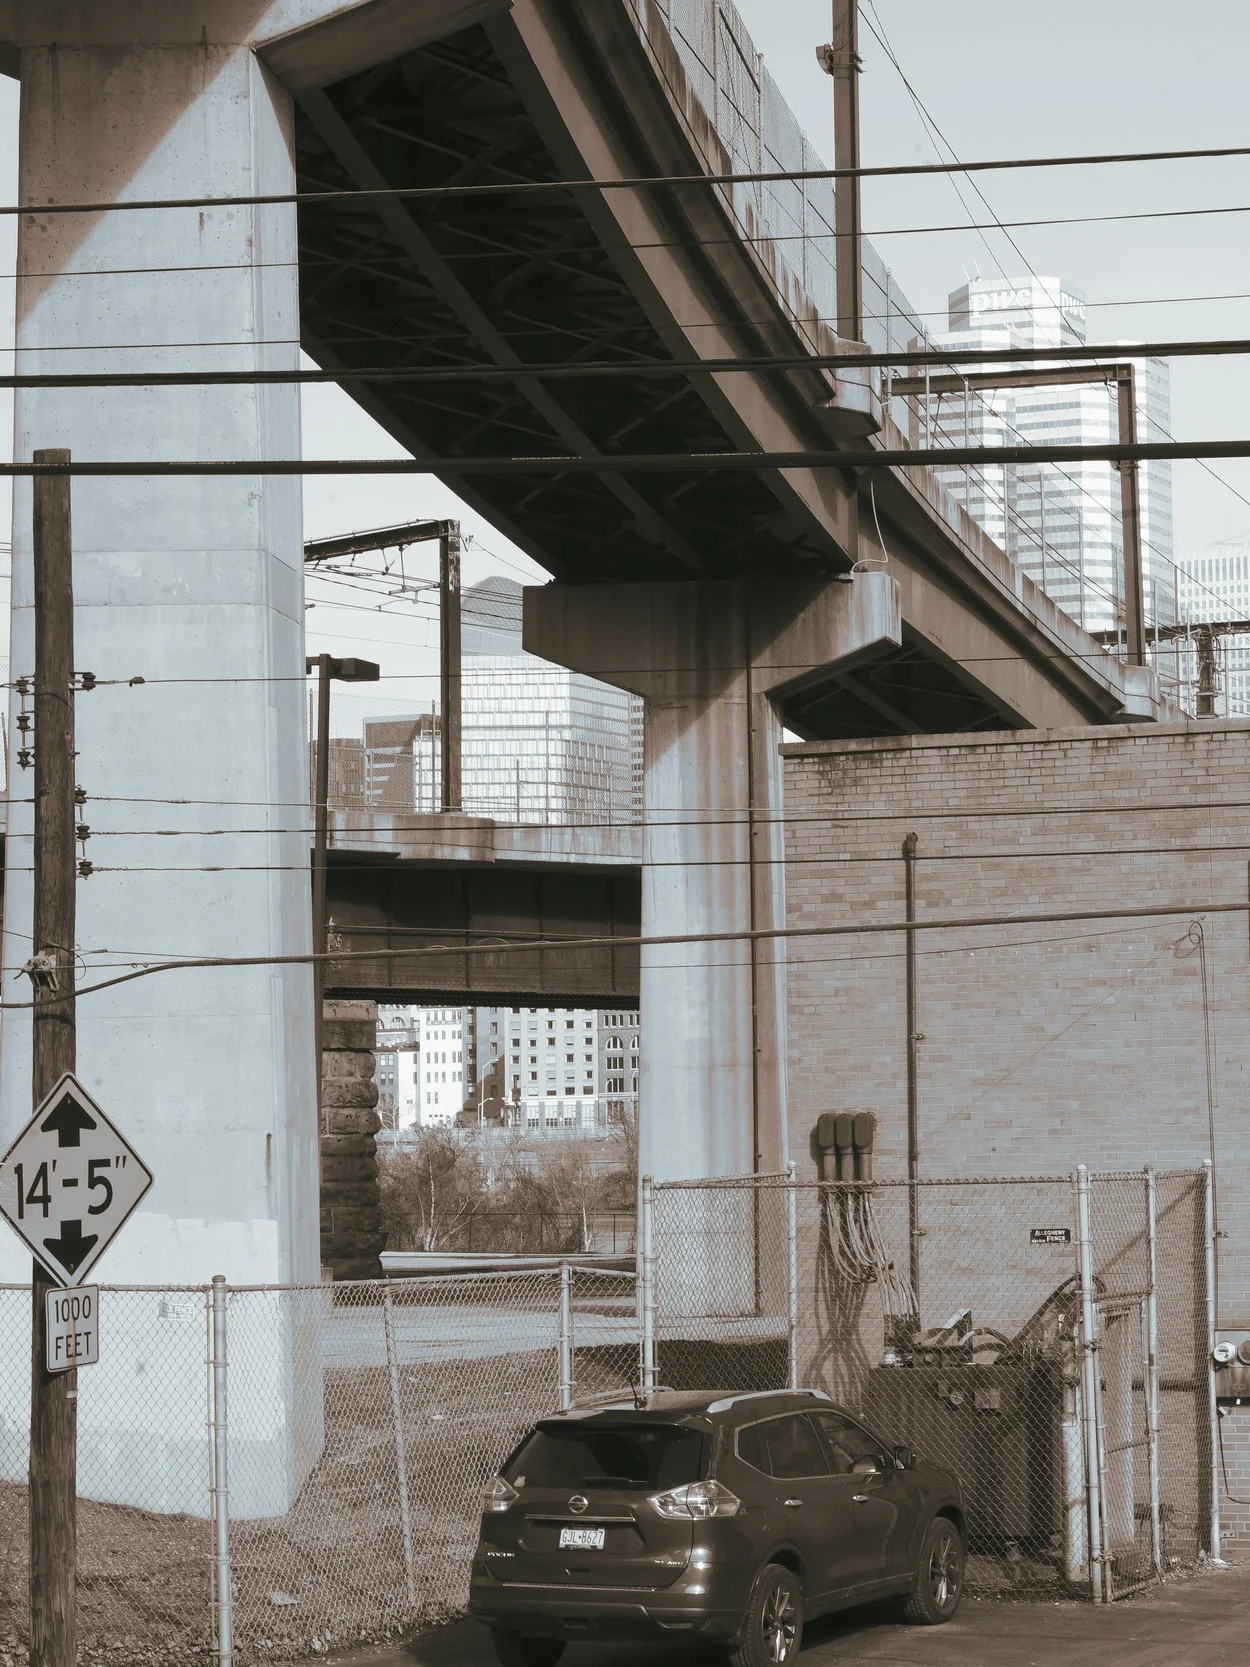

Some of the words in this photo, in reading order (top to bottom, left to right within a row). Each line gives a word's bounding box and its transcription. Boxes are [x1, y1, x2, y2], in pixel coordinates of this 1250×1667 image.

[970, 289, 1032, 318] pwc
[1061, 292, 1086, 320] pwc
[54, 1294, 91, 1324] 1000
[55, 1331, 92, 1361] FEET
